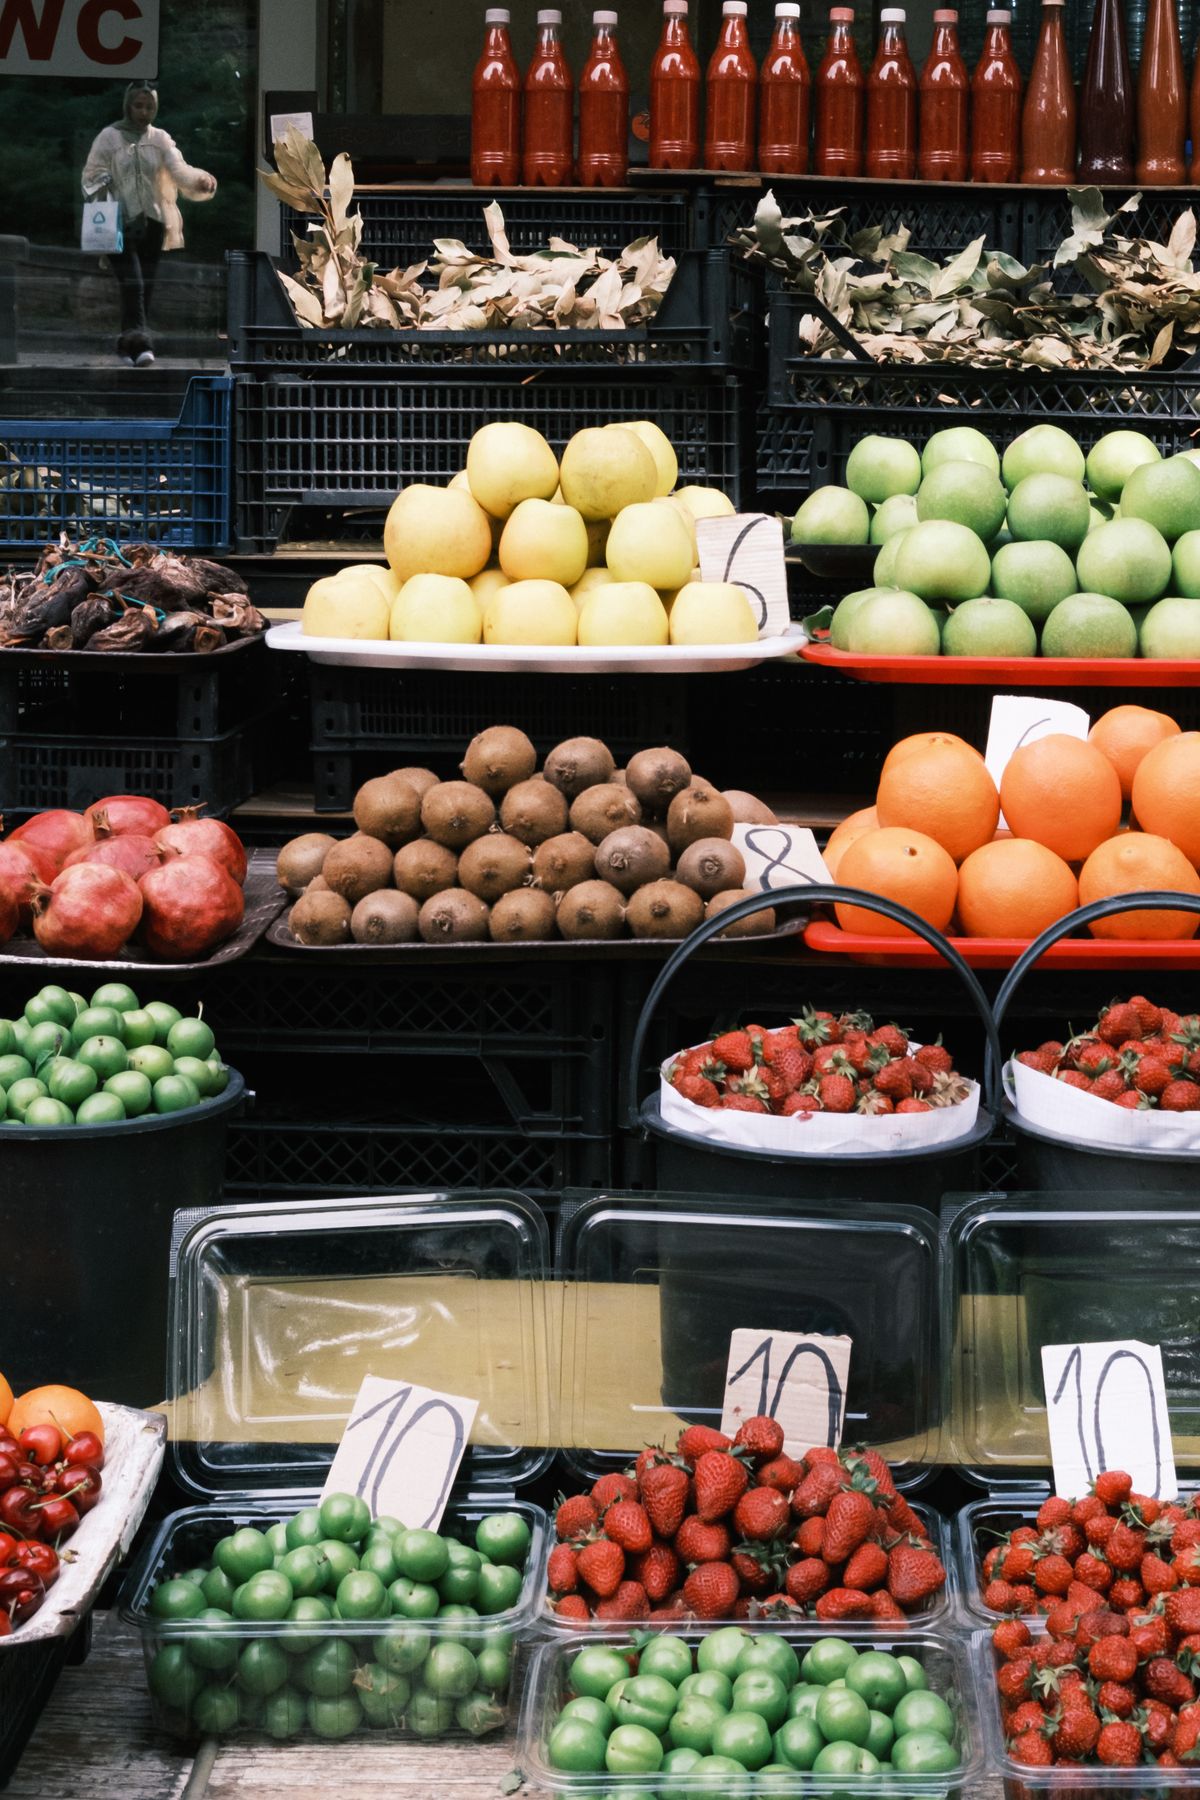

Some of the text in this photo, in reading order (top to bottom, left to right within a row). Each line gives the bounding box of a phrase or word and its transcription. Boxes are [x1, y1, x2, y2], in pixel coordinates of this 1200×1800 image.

[0, 0, 143, 65] WC
[744, 828, 820, 891] 8
[728, 1336, 842, 1448] 10
[1053, 1345, 1161, 1499] 10
[347, 1386, 464, 1529] 10
